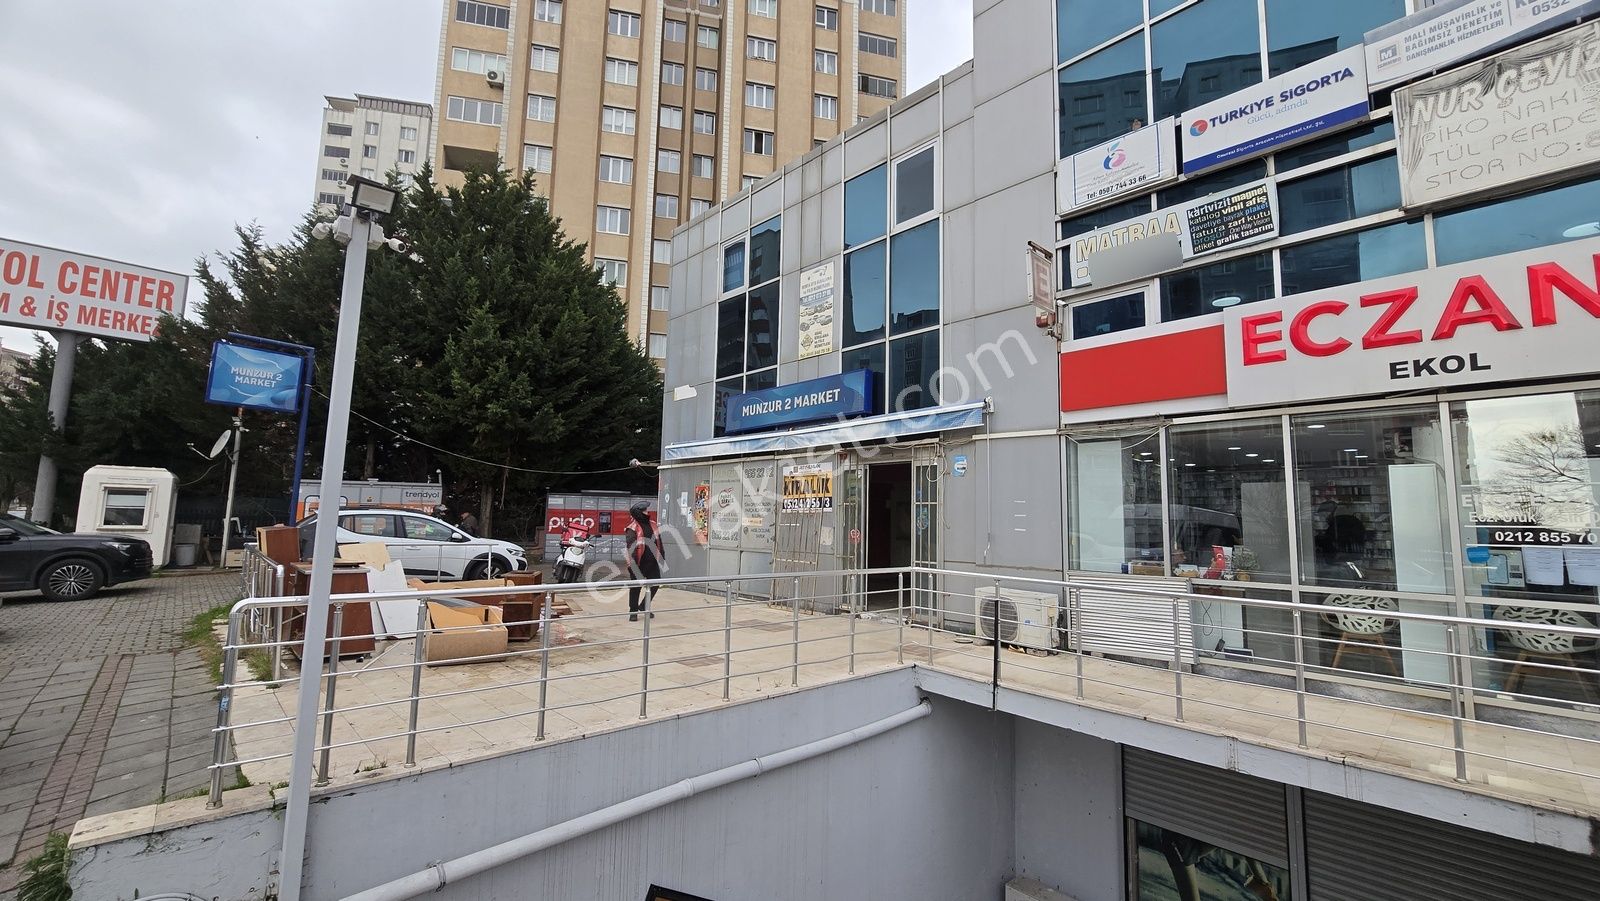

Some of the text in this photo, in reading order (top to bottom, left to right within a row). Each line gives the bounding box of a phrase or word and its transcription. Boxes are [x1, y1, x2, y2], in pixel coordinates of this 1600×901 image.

[1405, 9, 1502, 53] BAĞIMSIZ DENETİM
[1429, 5, 1486, 34] MÜŞAVİRLİK
[1406, 18, 1504, 61] DANIŞMANLIK HİZMETLERİ
[1276, 98, 1308, 115] adında
[1411, 81, 1484, 127] NUR
[1421, 117, 1489, 148] PİKO
[1428, 107, 1597, 166] TÜL PERDE
[1128, 177, 1137, 186] 33
[1425, 158, 1504, 191] STOR
[1188, 185, 1268, 219] kartvizit magnet
[1190, 194, 1267, 226] katalog vinil afiş
[1190, 201, 1269, 233] davetiye bayrak plaket
[1192, 210, 1271, 240] fatura zarf kutu
[1194, 223, 1274, 253] etiket grafik tasarım
[0, 249, 175, 312] OL CENTER
[19, 296, 37, 317] &
[47, 295, 69, 327] İŞ
[1241, 253, 1600, 367] ECZAN
[230, 366, 274, 380] MUNZUR
[1389, 352, 1491, 380] EKOL
[235, 376, 276, 388] MARKET
[742, 400, 782, 417] MUNZUR
[784, 398, 791, 410] 2
[794, 388, 840, 409] MARKET
[405, 490, 440, 499] trendyol
[1494, 531, 1598, 544] 0212 855 70
